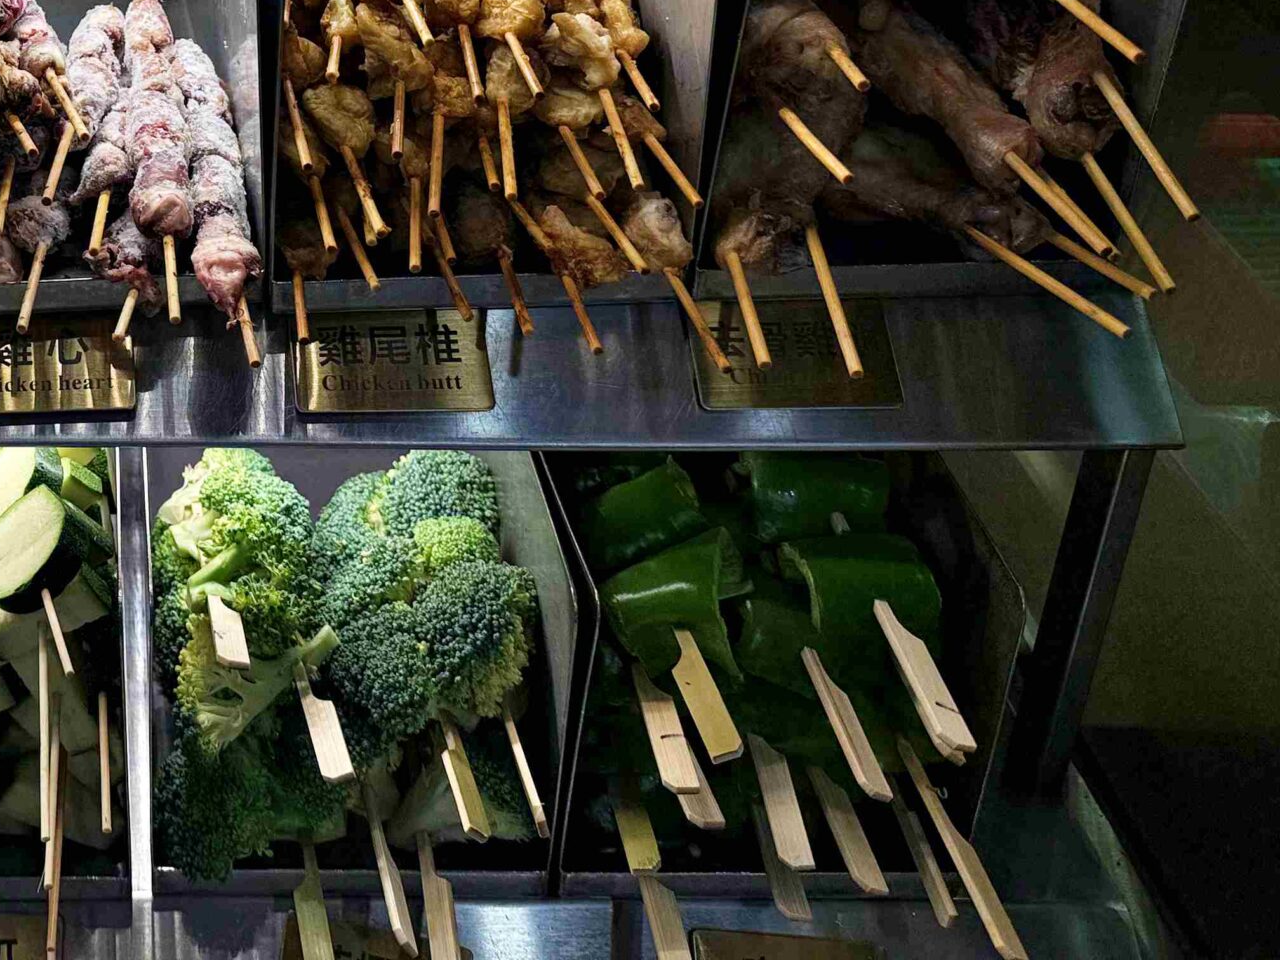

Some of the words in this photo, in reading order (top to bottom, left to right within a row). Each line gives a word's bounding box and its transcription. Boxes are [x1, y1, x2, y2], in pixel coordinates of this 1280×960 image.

[316, 323, 463, 367] 雞尾椎
[59, 374, 114, 391] heart
[322, 374, 412, 391] Chicken
[418, 373, 464, 391] butt
